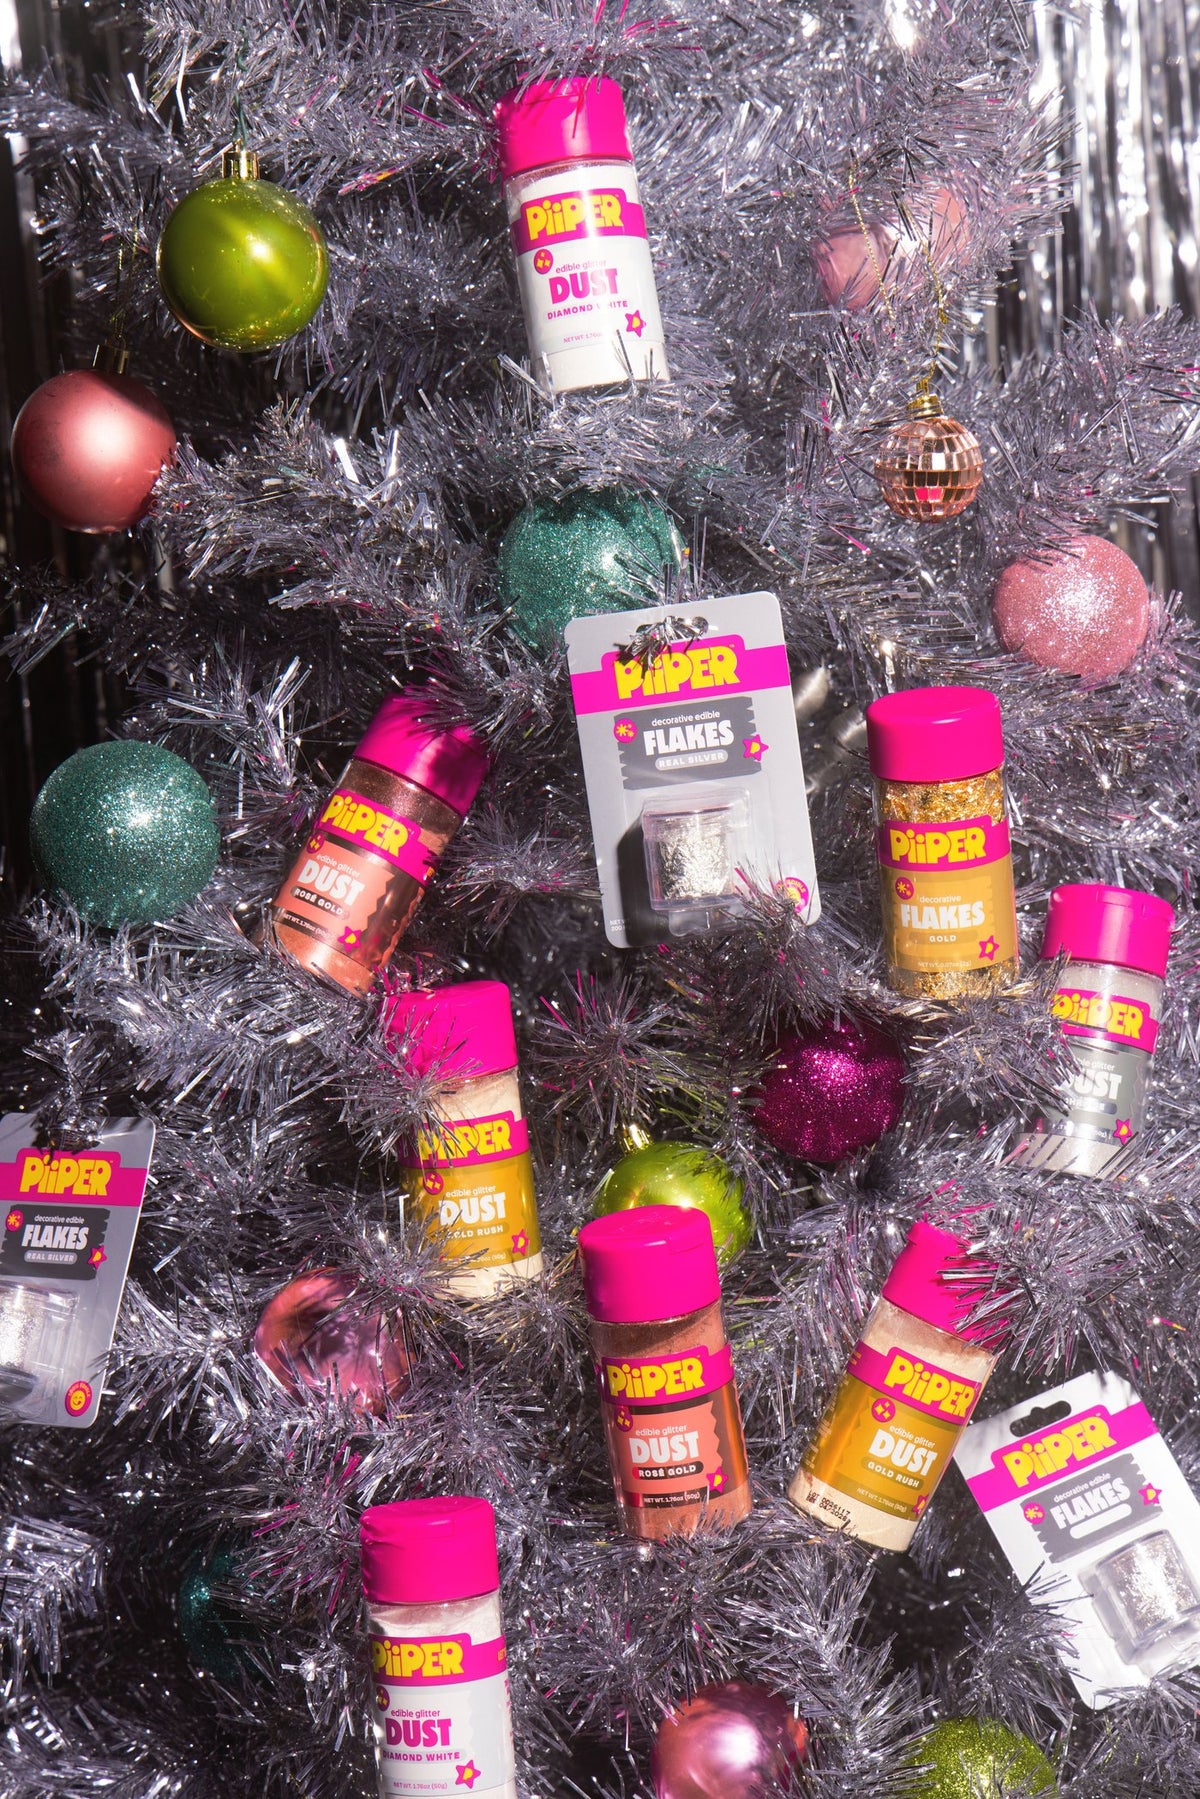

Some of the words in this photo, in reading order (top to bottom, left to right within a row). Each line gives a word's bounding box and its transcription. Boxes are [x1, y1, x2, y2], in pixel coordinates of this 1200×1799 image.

[556, 263, 580, 274] edible
[548, 268, 618, 304] DUST
[548, 304, 593, 320] DIAMOND
[651, 714, 693, 727] decorative
[695, 710, 720, 721] edible
[643, 719, 734, 756] FLAKES
[659, 758, 685, 768] REAL
[691, 752, 724, 764] SILVER
[321, 795, 409, 857] PiiPER
[889, 827, 986, 864] PiiPER
[316, 854, 337, 866] edible
[337, 863, 360, 878] glitter
[297, 859, 366, 906] DUST
[318, 898, 343, 915] GOLD
[919, 895, 961, 903] decorative
[900, 901, 985, 930] FLAKES
[929, 935, 956, 943] GOLD
[1067, 1066, 1122, 1100] UST
[446, 1188, 471, 1197] edible
[473, 1185, 496, 1196] glitter
[34, 1214, 65, 1223] decorative
[65, 1216, 84, 1224] edible
[438, 1192, 506, 1226] DUST
[21, 1224, 89, 1250] FLAKES
[477, 1225, 503, 1236] RUSH
[47, 1253, 74, 1262] SILVER
[606, 1357, 705, 1398] PiiPER
[883, 1354, 975, 1418] PiiPER
[635, 1427, 661, 1436] edible
[662, 1424, 687, 1436] glitter
[889, 1425, 914, 1441] edible
[913, 1435, 936, 1449] glitter
[629, 1431, 699, 1463] DUST
[869, 1429, 938, 1477] DUST
[1002, 1416, 1117, 1488] PiiPER
[638, 1466, 665, 1477] ROSÉ
[668, 1464, 697, 1476] GOLD
[868, 1461, 894, 1478] GOLD
[896, 1471, 919, 1488] RUSH
[1054, 1483, 1089, 1502] decorative
[1089, 1473, 1111, 1487] edible
[1049, 1477, 1130, 1530] FLAKES
[391, 1709, 413, 1717] edible
[415, 1709, 440, 1719] glitter
[385, 1718, 452, 1747] DUST
[383, 1750, 422, 1761] DIAMOND
[426, 1752, 460, 1761] WHITE
